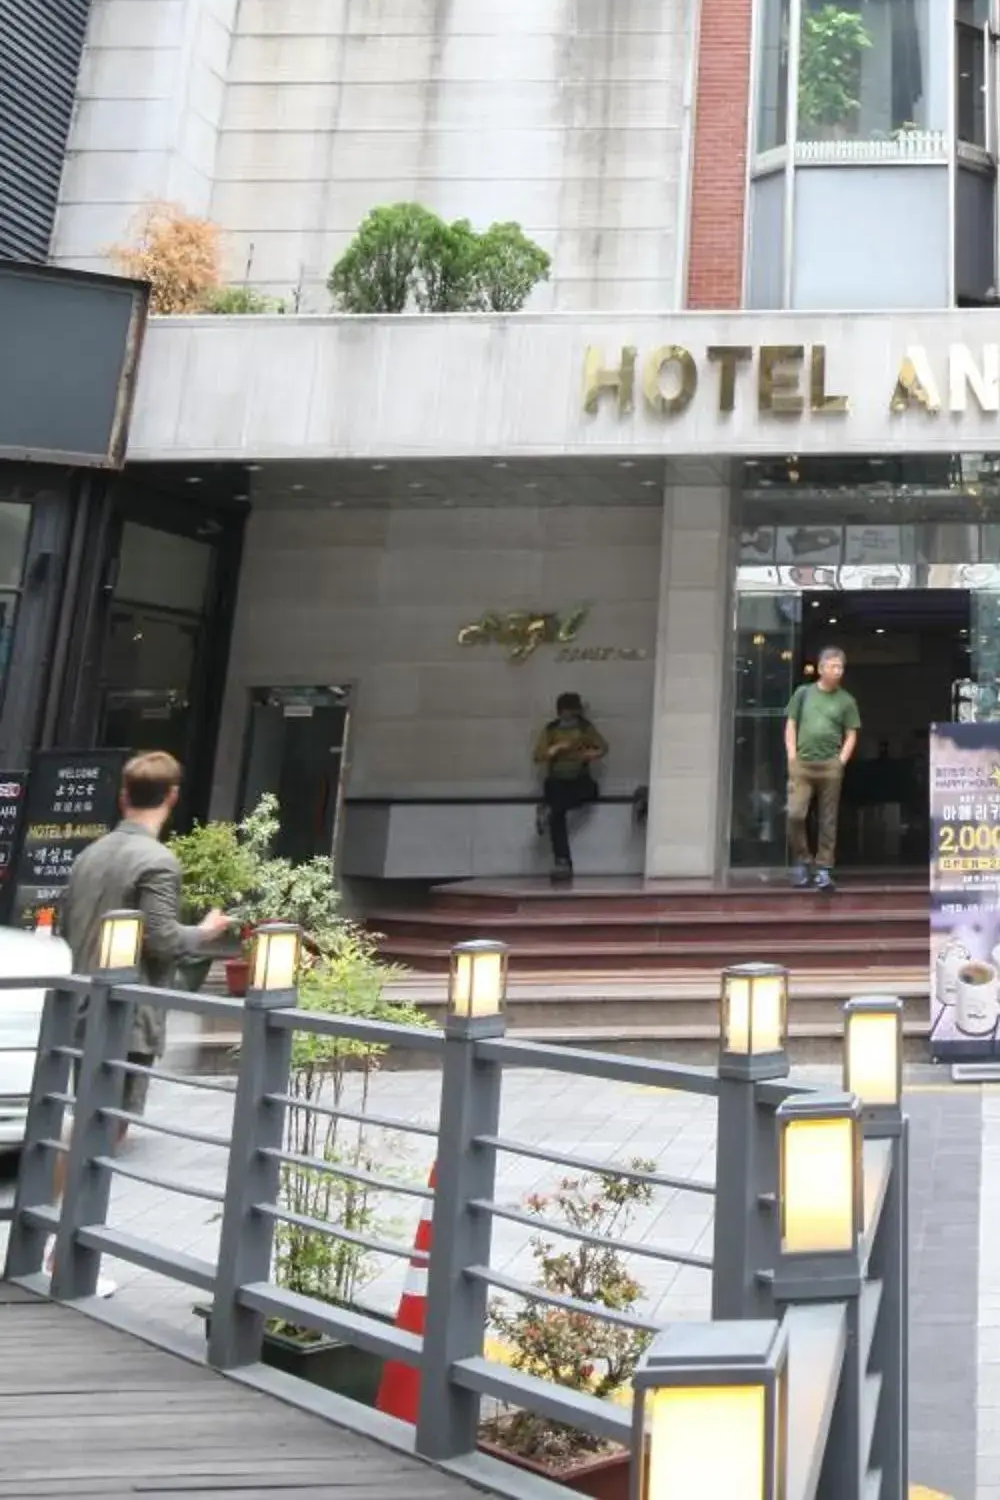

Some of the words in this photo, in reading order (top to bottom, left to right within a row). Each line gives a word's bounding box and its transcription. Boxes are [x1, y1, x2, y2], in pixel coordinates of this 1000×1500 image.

[582, 344, 850, 416] HOTEL
[55, 783, 96, 797] ようこそ
